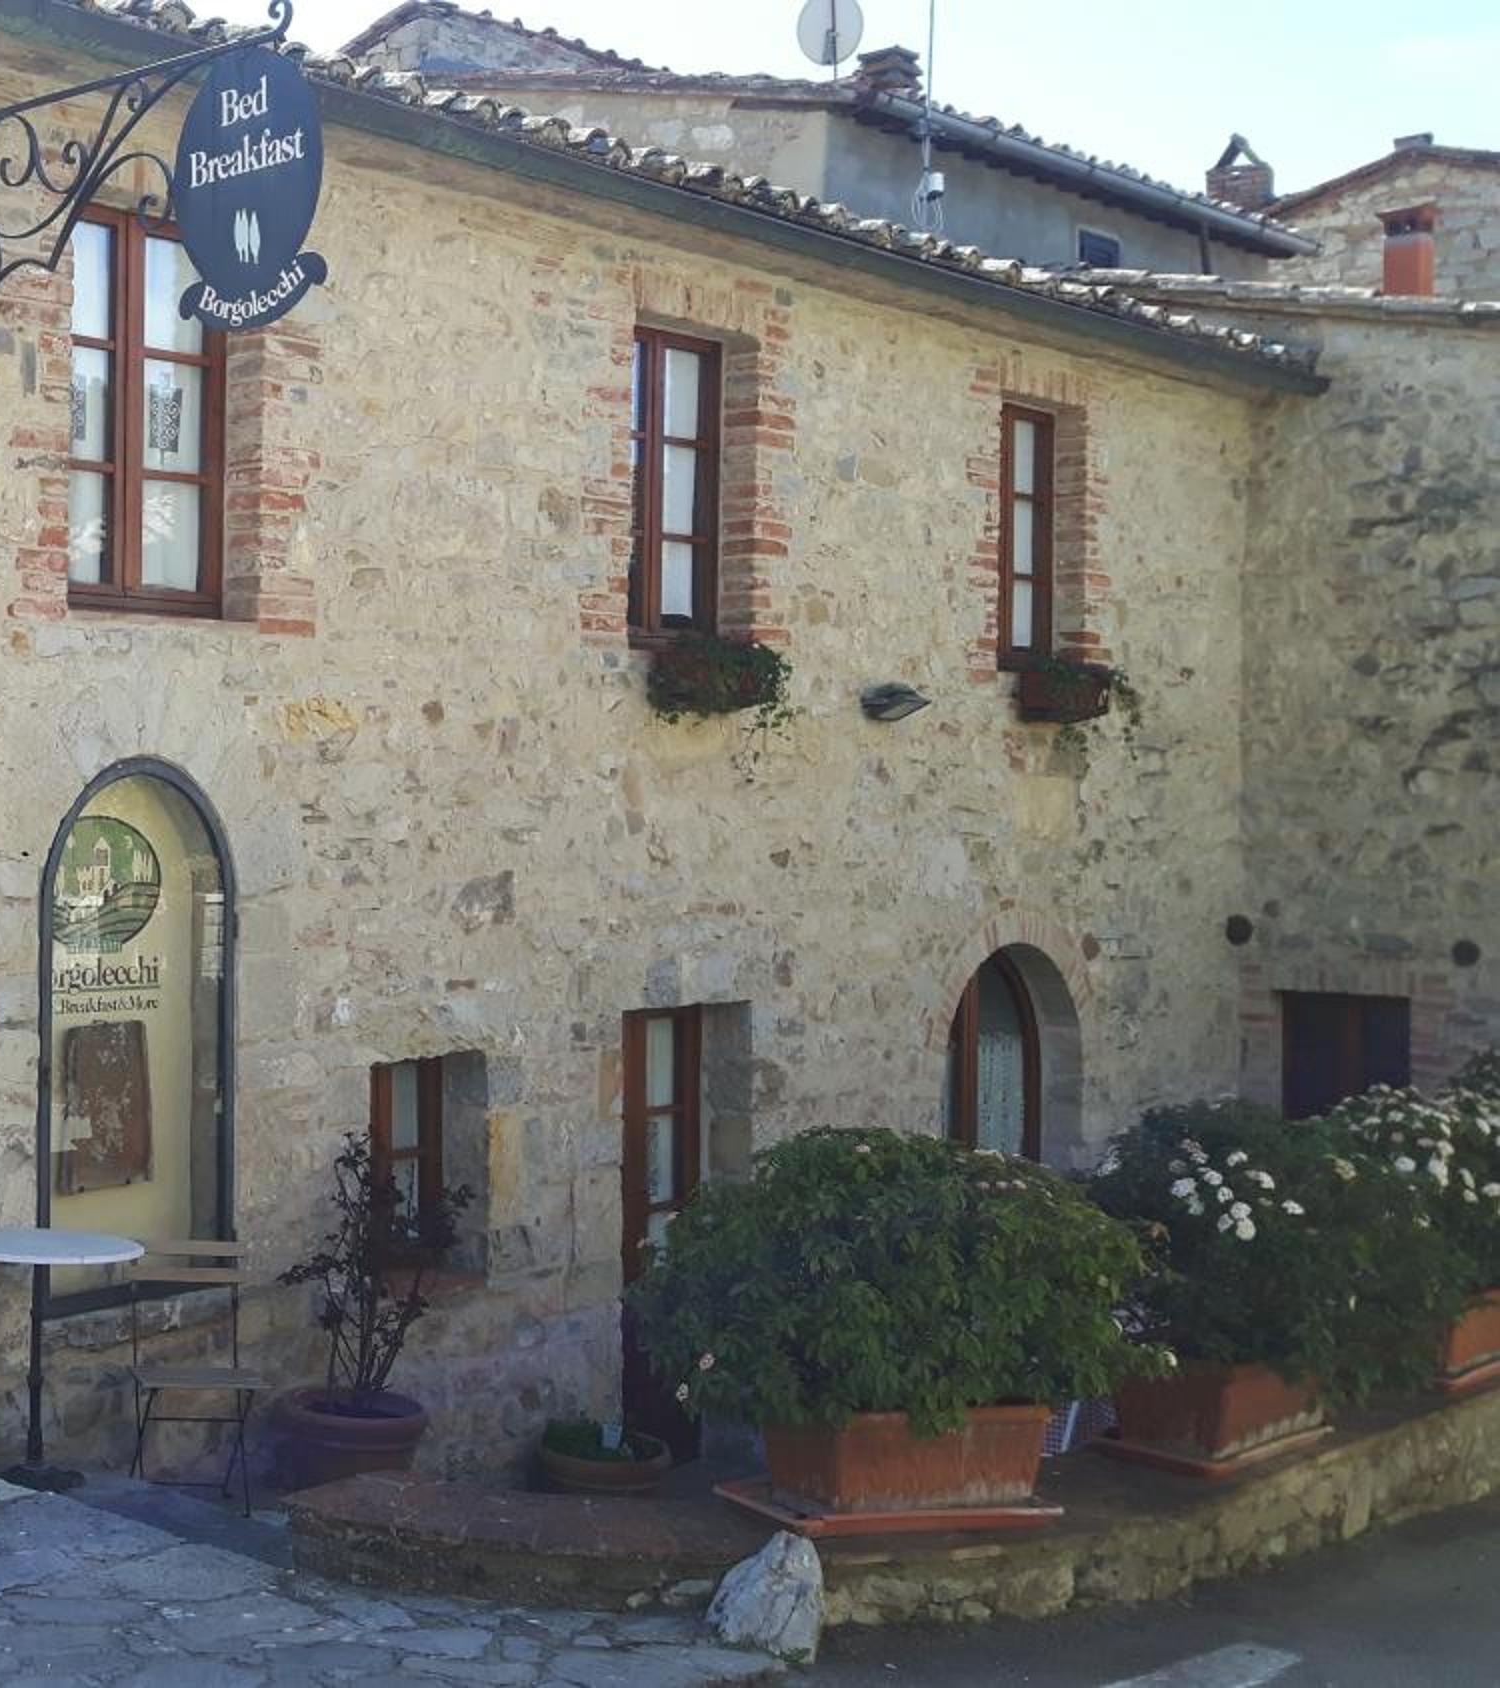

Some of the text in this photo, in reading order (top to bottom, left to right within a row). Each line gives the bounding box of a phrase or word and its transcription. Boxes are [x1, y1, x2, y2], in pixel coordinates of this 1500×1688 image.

[220, 75, 268, 127] Bed
[190, 127, 305, 189] Breakfast
[200, 259, 306, 327] Borgolecchi
